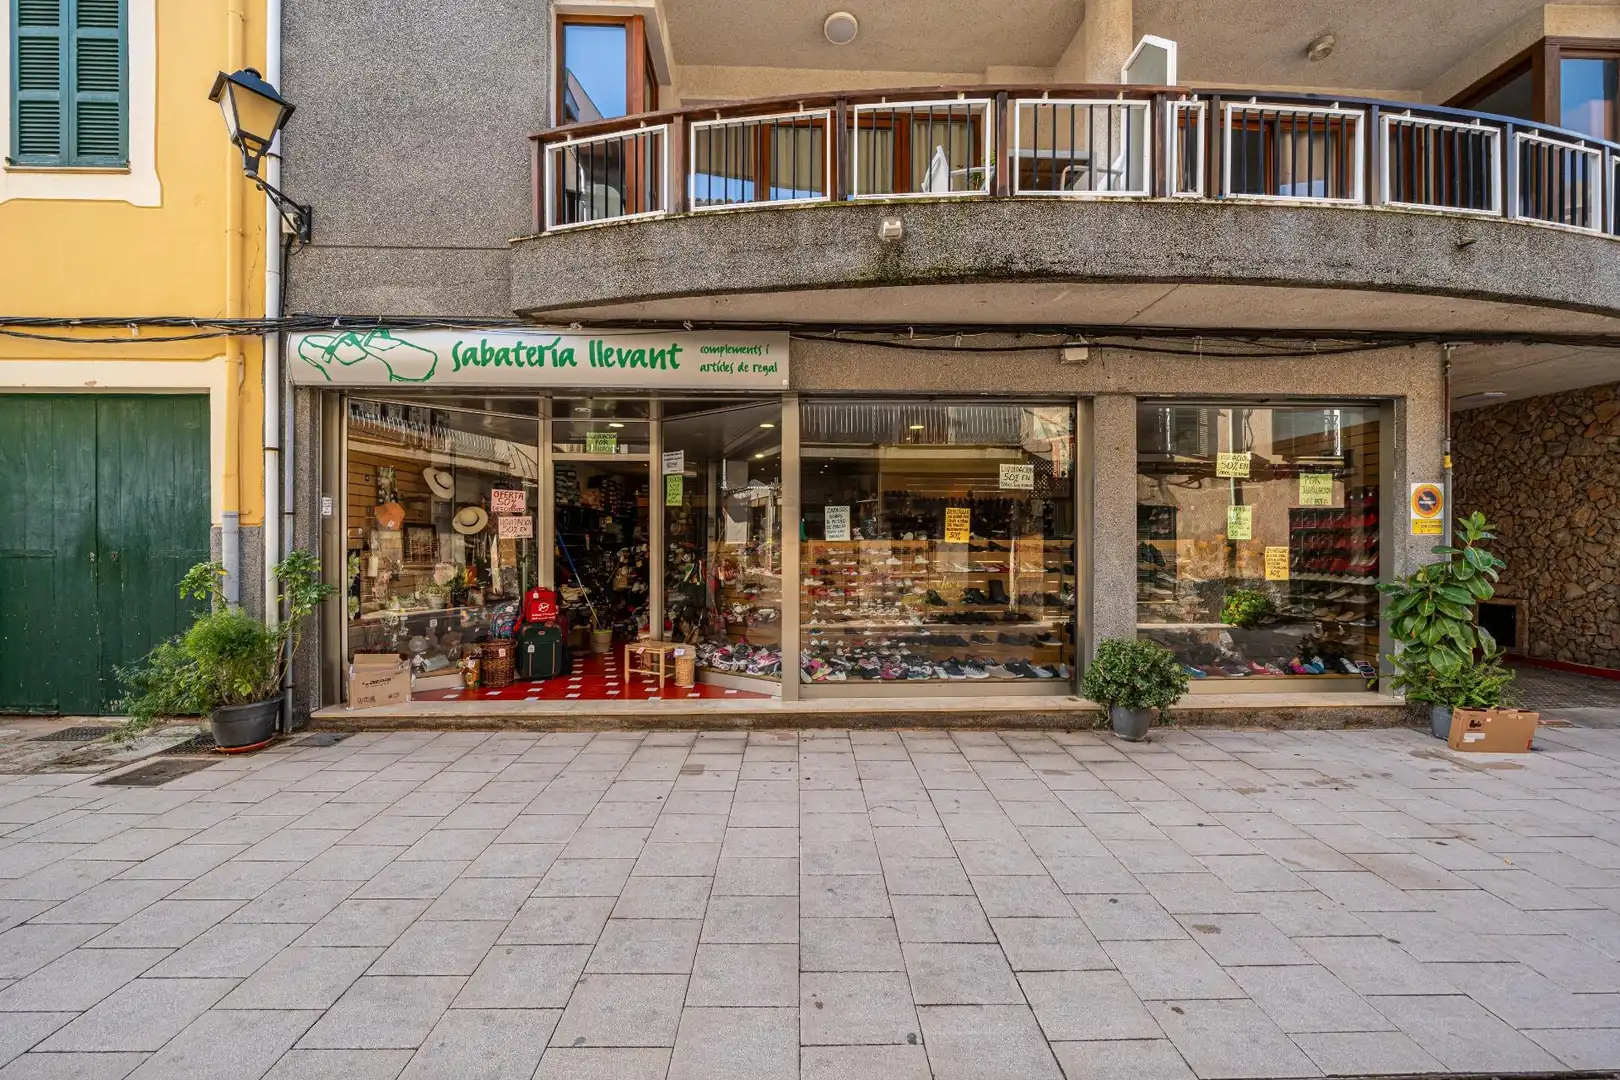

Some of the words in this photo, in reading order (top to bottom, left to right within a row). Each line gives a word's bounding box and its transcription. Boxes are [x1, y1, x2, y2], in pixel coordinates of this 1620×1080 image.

[589, 339, 683, 370] llevant
[700, 344, 762, 357] complements
[738, 362, 749, 372] de
[753, 362, 778, 376] regal
[1221, 461, 1239, 470] 50%
[1003, 473, 1020, 482] 50%
[1304, 475, 1320, 484] POR
[494, 491, 524, 500] OFERTA
[497, 498, 516, 506] 50%
